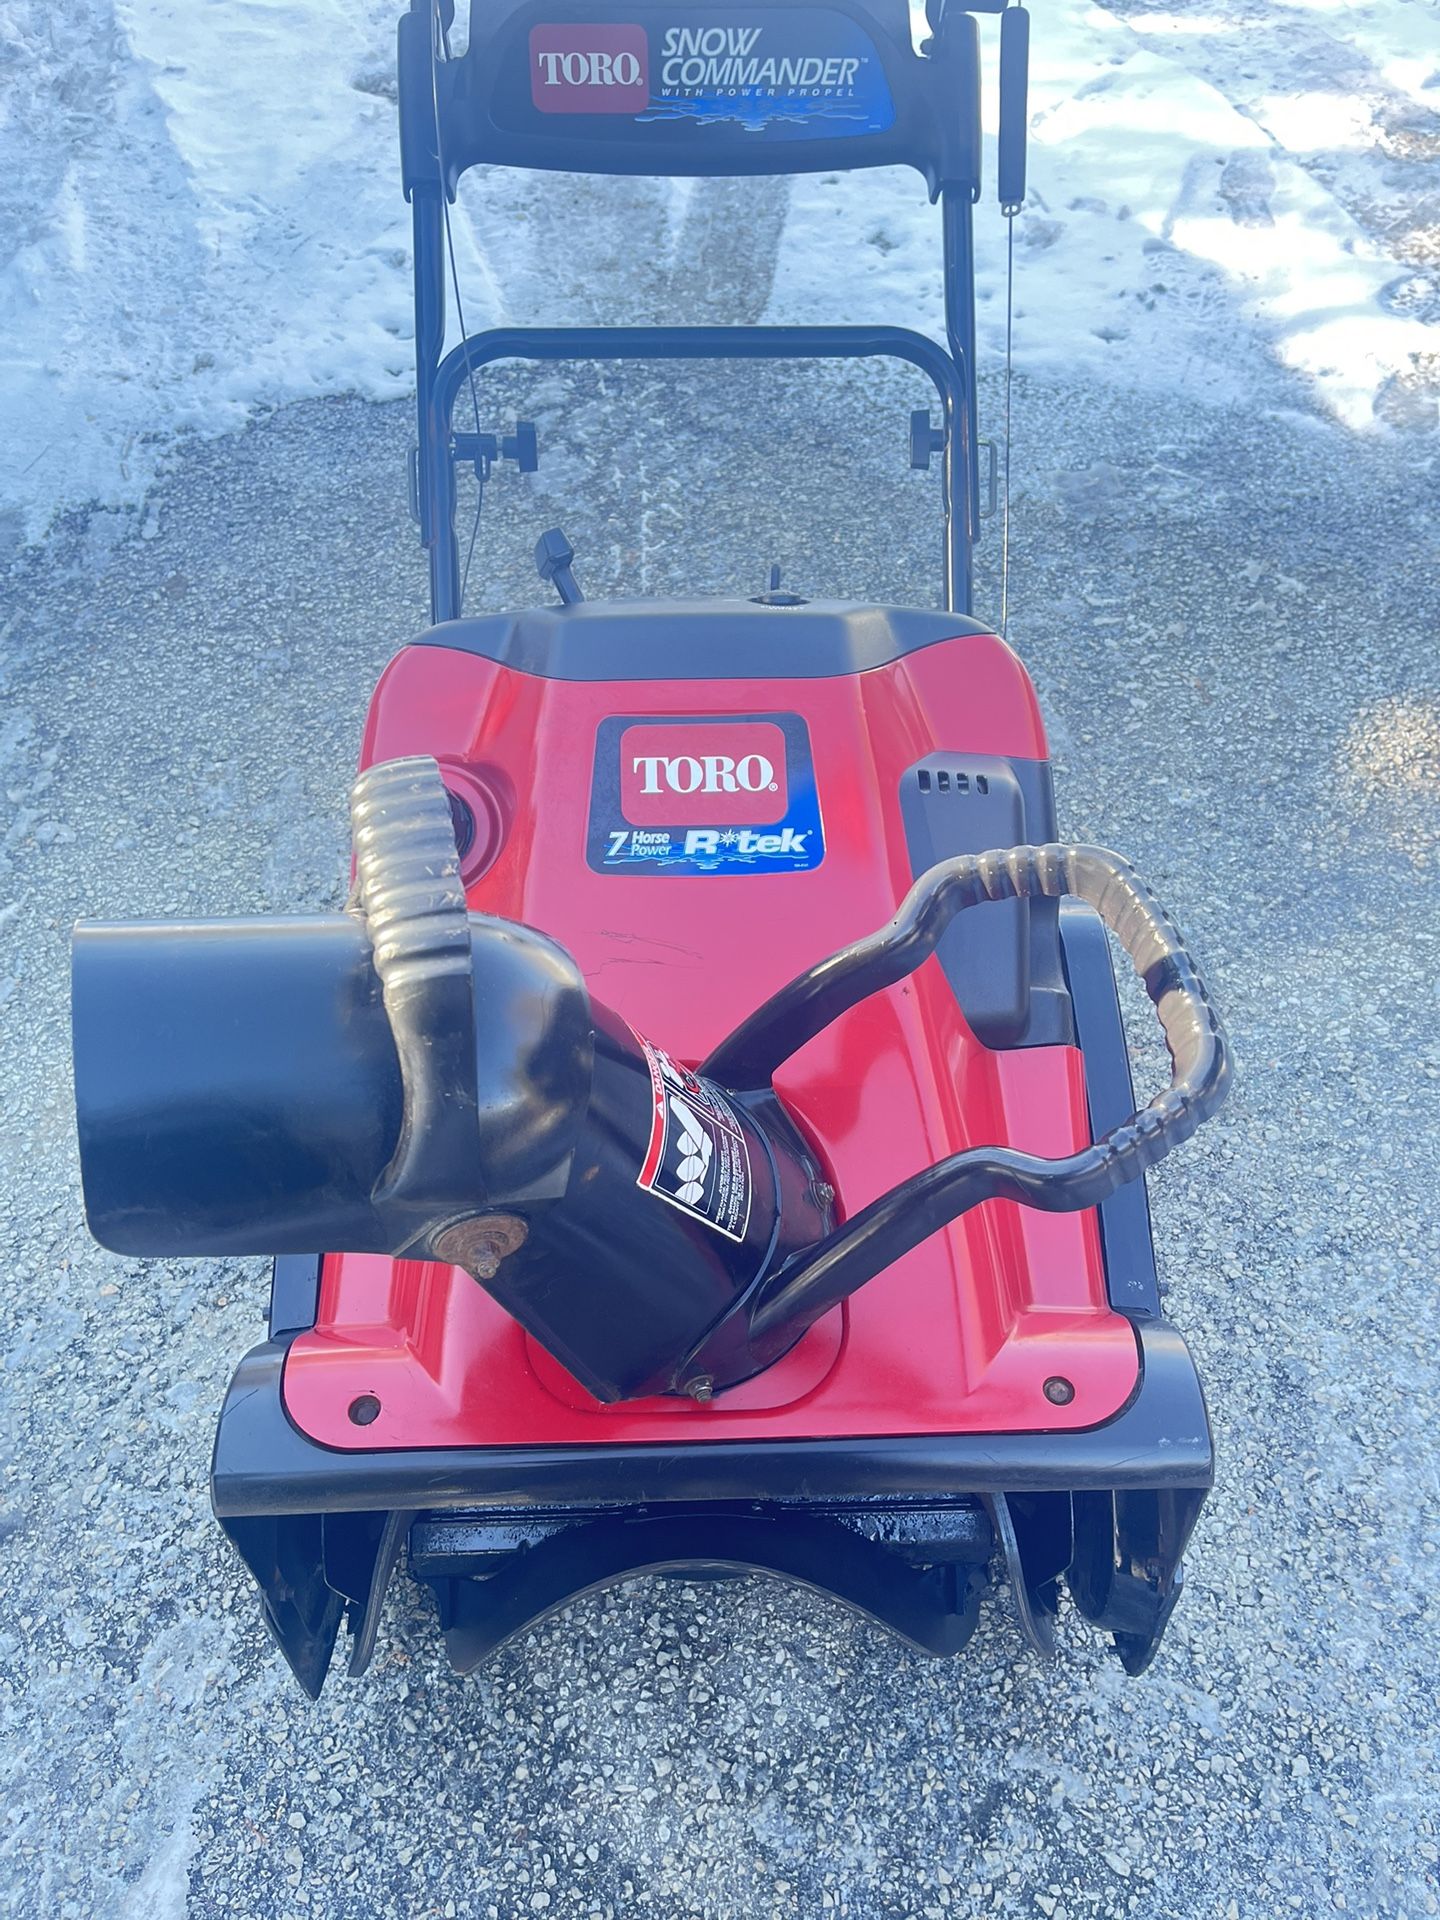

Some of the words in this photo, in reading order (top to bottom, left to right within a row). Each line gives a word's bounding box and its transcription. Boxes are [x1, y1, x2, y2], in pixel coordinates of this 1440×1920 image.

[661, 27, 763, 57] SNOW
[661, 88, 704, 97] WITH
[716, 88, 776, 97] POWER
[788, 88, 856, 97] PROPEL
[606, 831, 630, 856] 7
[631, 830, 670, 844] Horse
[630, 844, 673, 856] Power
